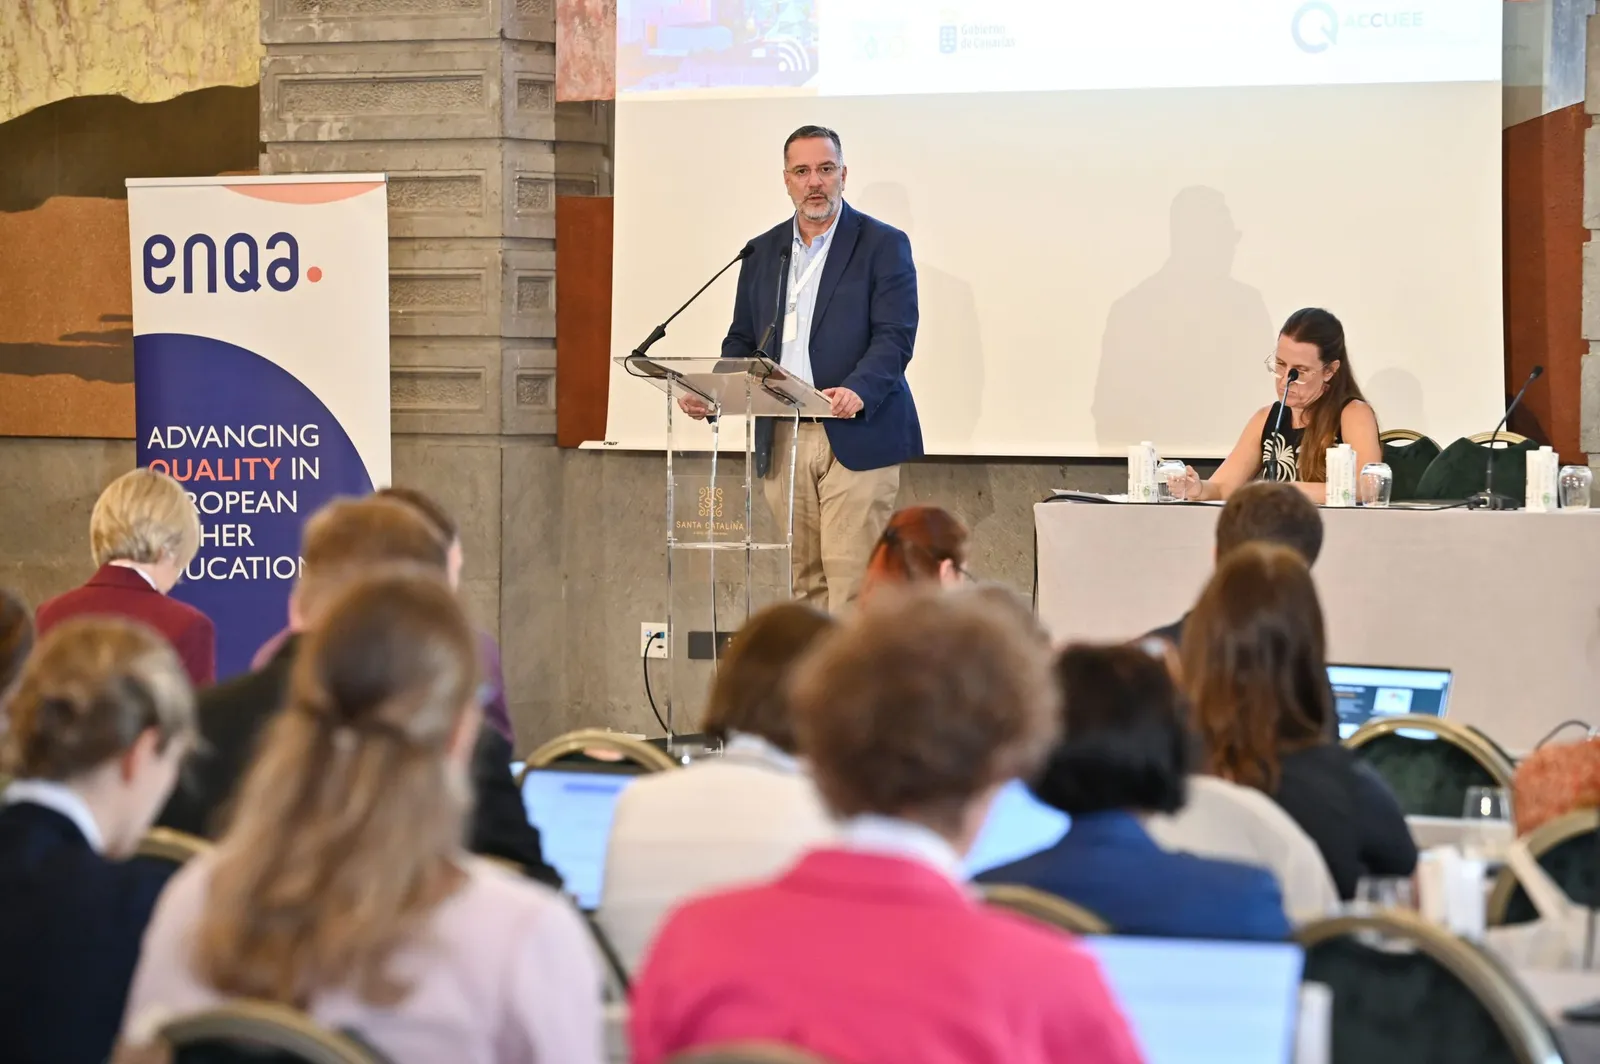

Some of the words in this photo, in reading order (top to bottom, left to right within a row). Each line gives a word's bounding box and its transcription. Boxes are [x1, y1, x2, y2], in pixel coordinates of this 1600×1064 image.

[961, 24, 1005, 35] Gobierno
[1344, 11, 1424, 28] ACCUEE
[961, 37, 972, 49] de
[974, 36, 1016, 48] Canarias
[147, 424, 320, 449] ADVANCING
[291, 456, 320, 480] IN
[185, 490, 298, 515] ROPEAN
[199, 523, 255, 547] HER
[676, 520, 702, 529] SANTA
[178, 555, 307, 581] UCATIO
